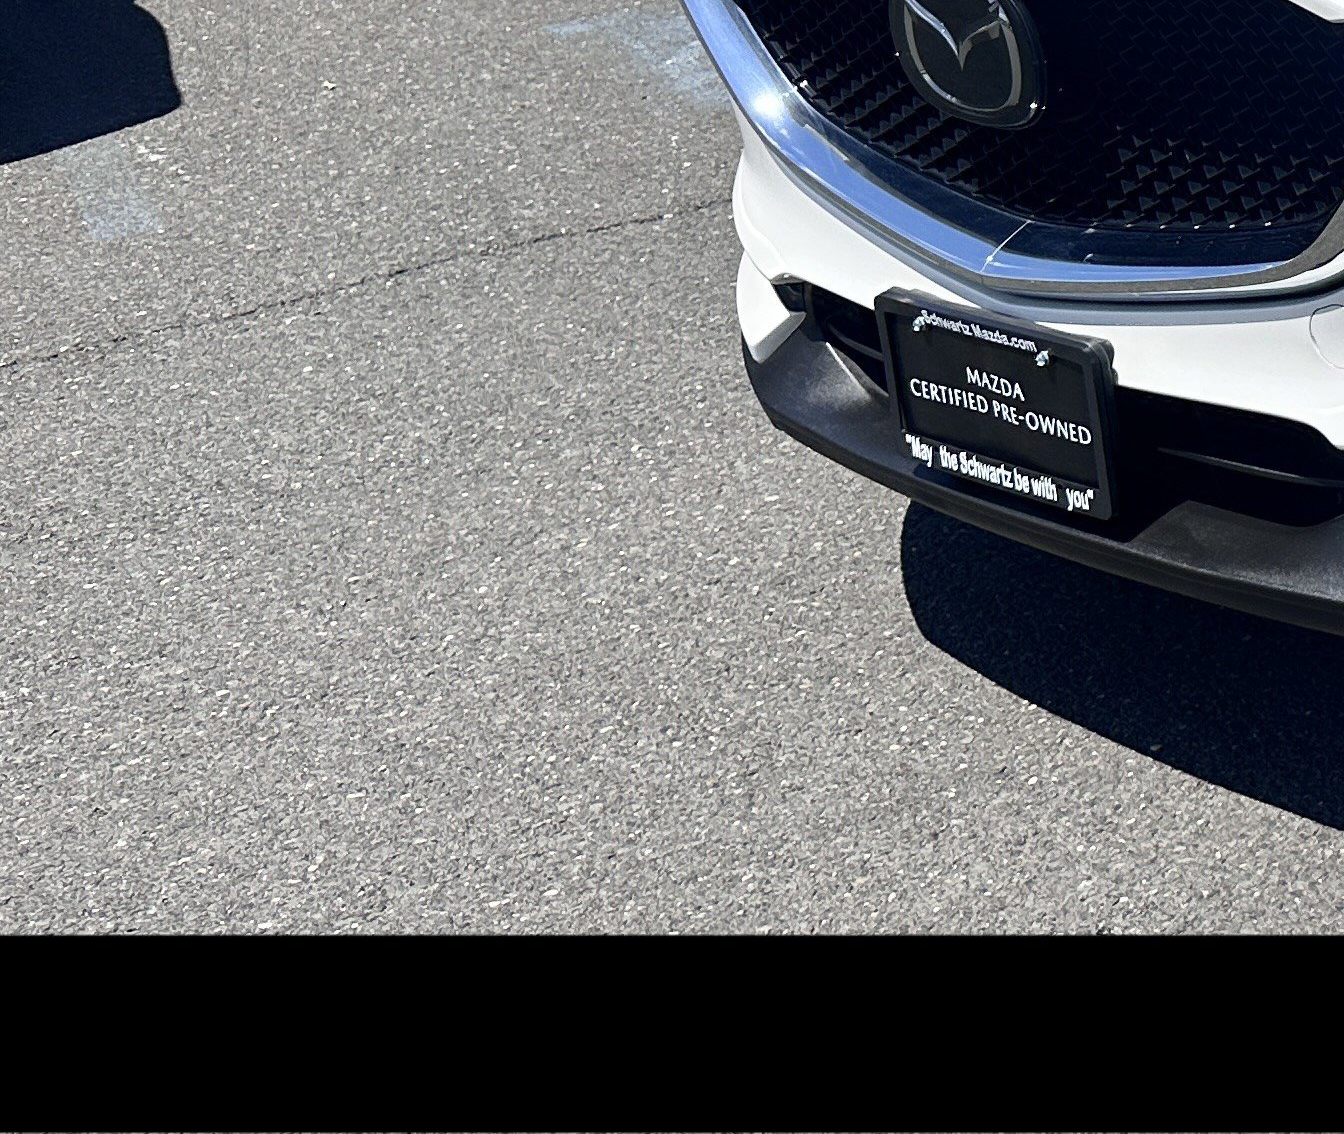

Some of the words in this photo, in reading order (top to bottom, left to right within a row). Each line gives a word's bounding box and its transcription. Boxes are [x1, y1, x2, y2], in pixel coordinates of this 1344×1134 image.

[910, 378, 989, 414] CERTIFIED
[992, 399, 1092, 446] PRE-OWNED
[965, 366, 1026, 402] MAZDA
[939, 444, 959, 472] the
[958, 451, 1014, 490] Schwartz
[1013, 467, 1031, 494] be
[1030, 475, 1058, 502] with
